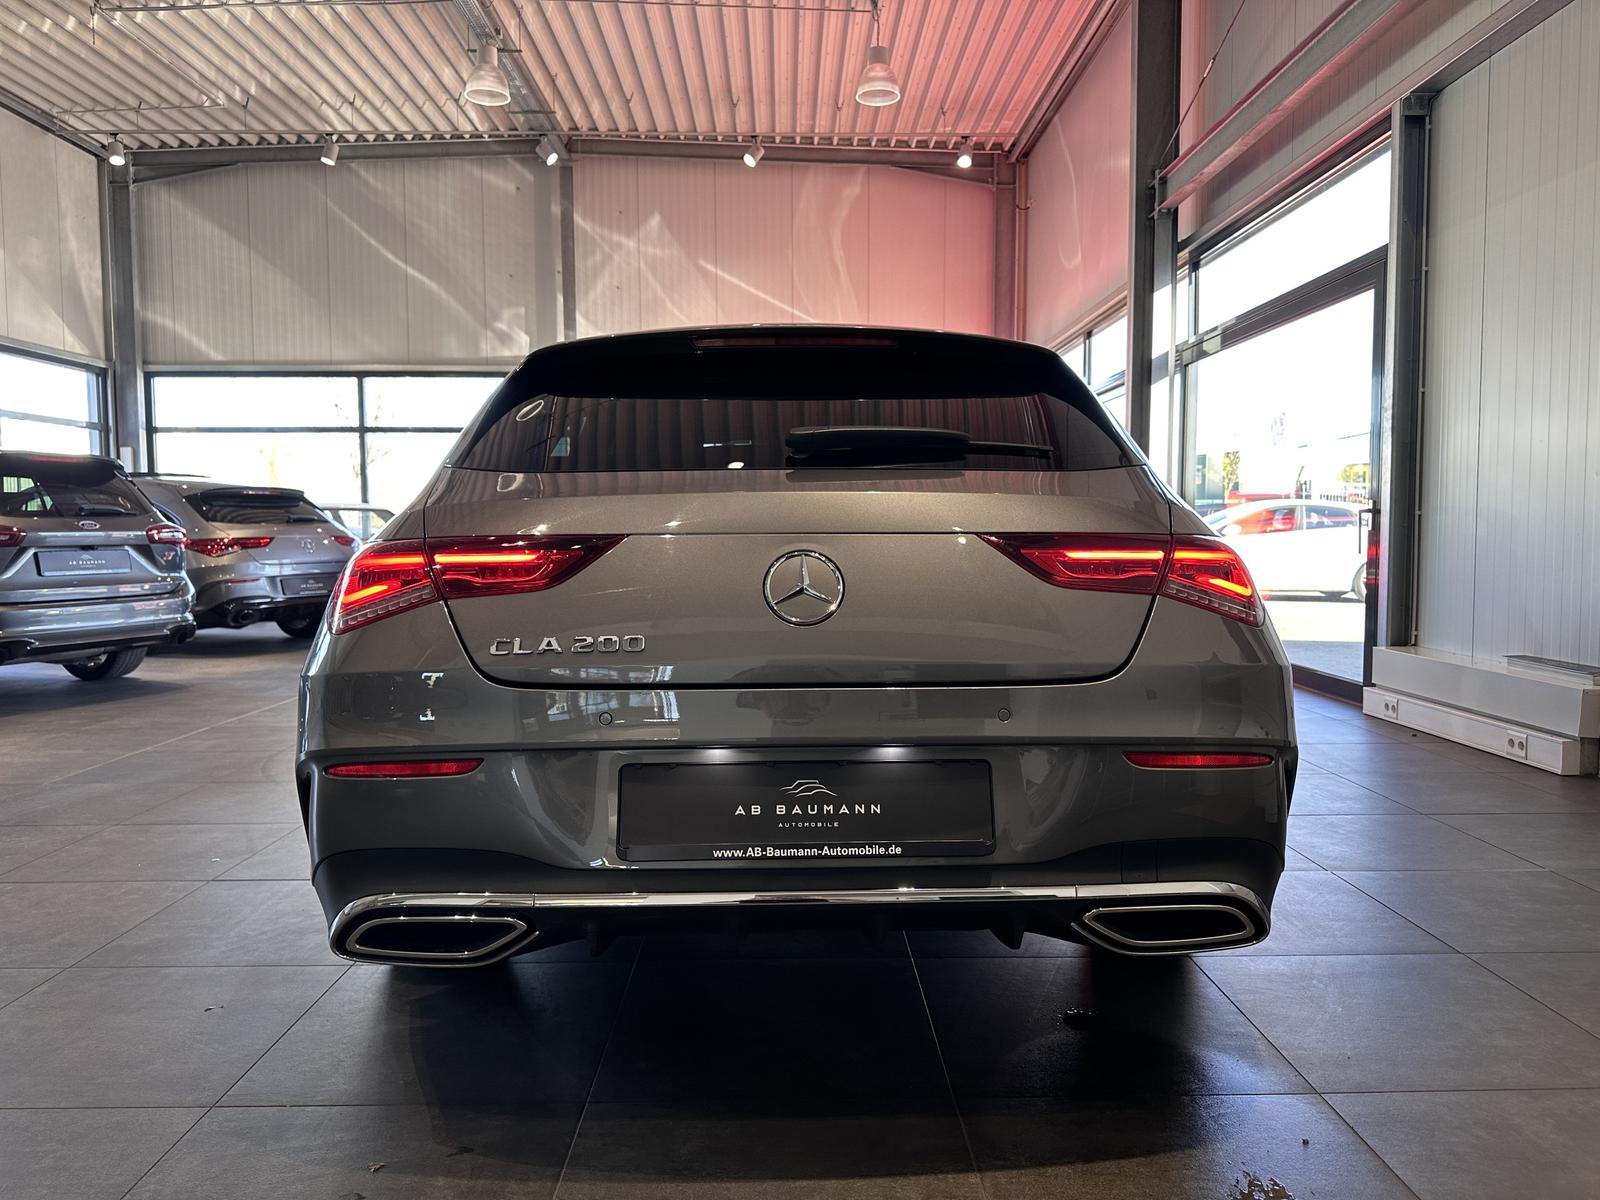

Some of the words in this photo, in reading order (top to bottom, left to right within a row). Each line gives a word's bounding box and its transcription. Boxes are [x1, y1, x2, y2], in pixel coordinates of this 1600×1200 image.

[489, 636, 563, 655] CLA
[571, 635, 645, 653] 200
[735, 804, 761, 816] AB
[776, 803, 881, 815] BAUMANN
[713, 844, 902, 858] www.AB-Baumann-Automobile.de
